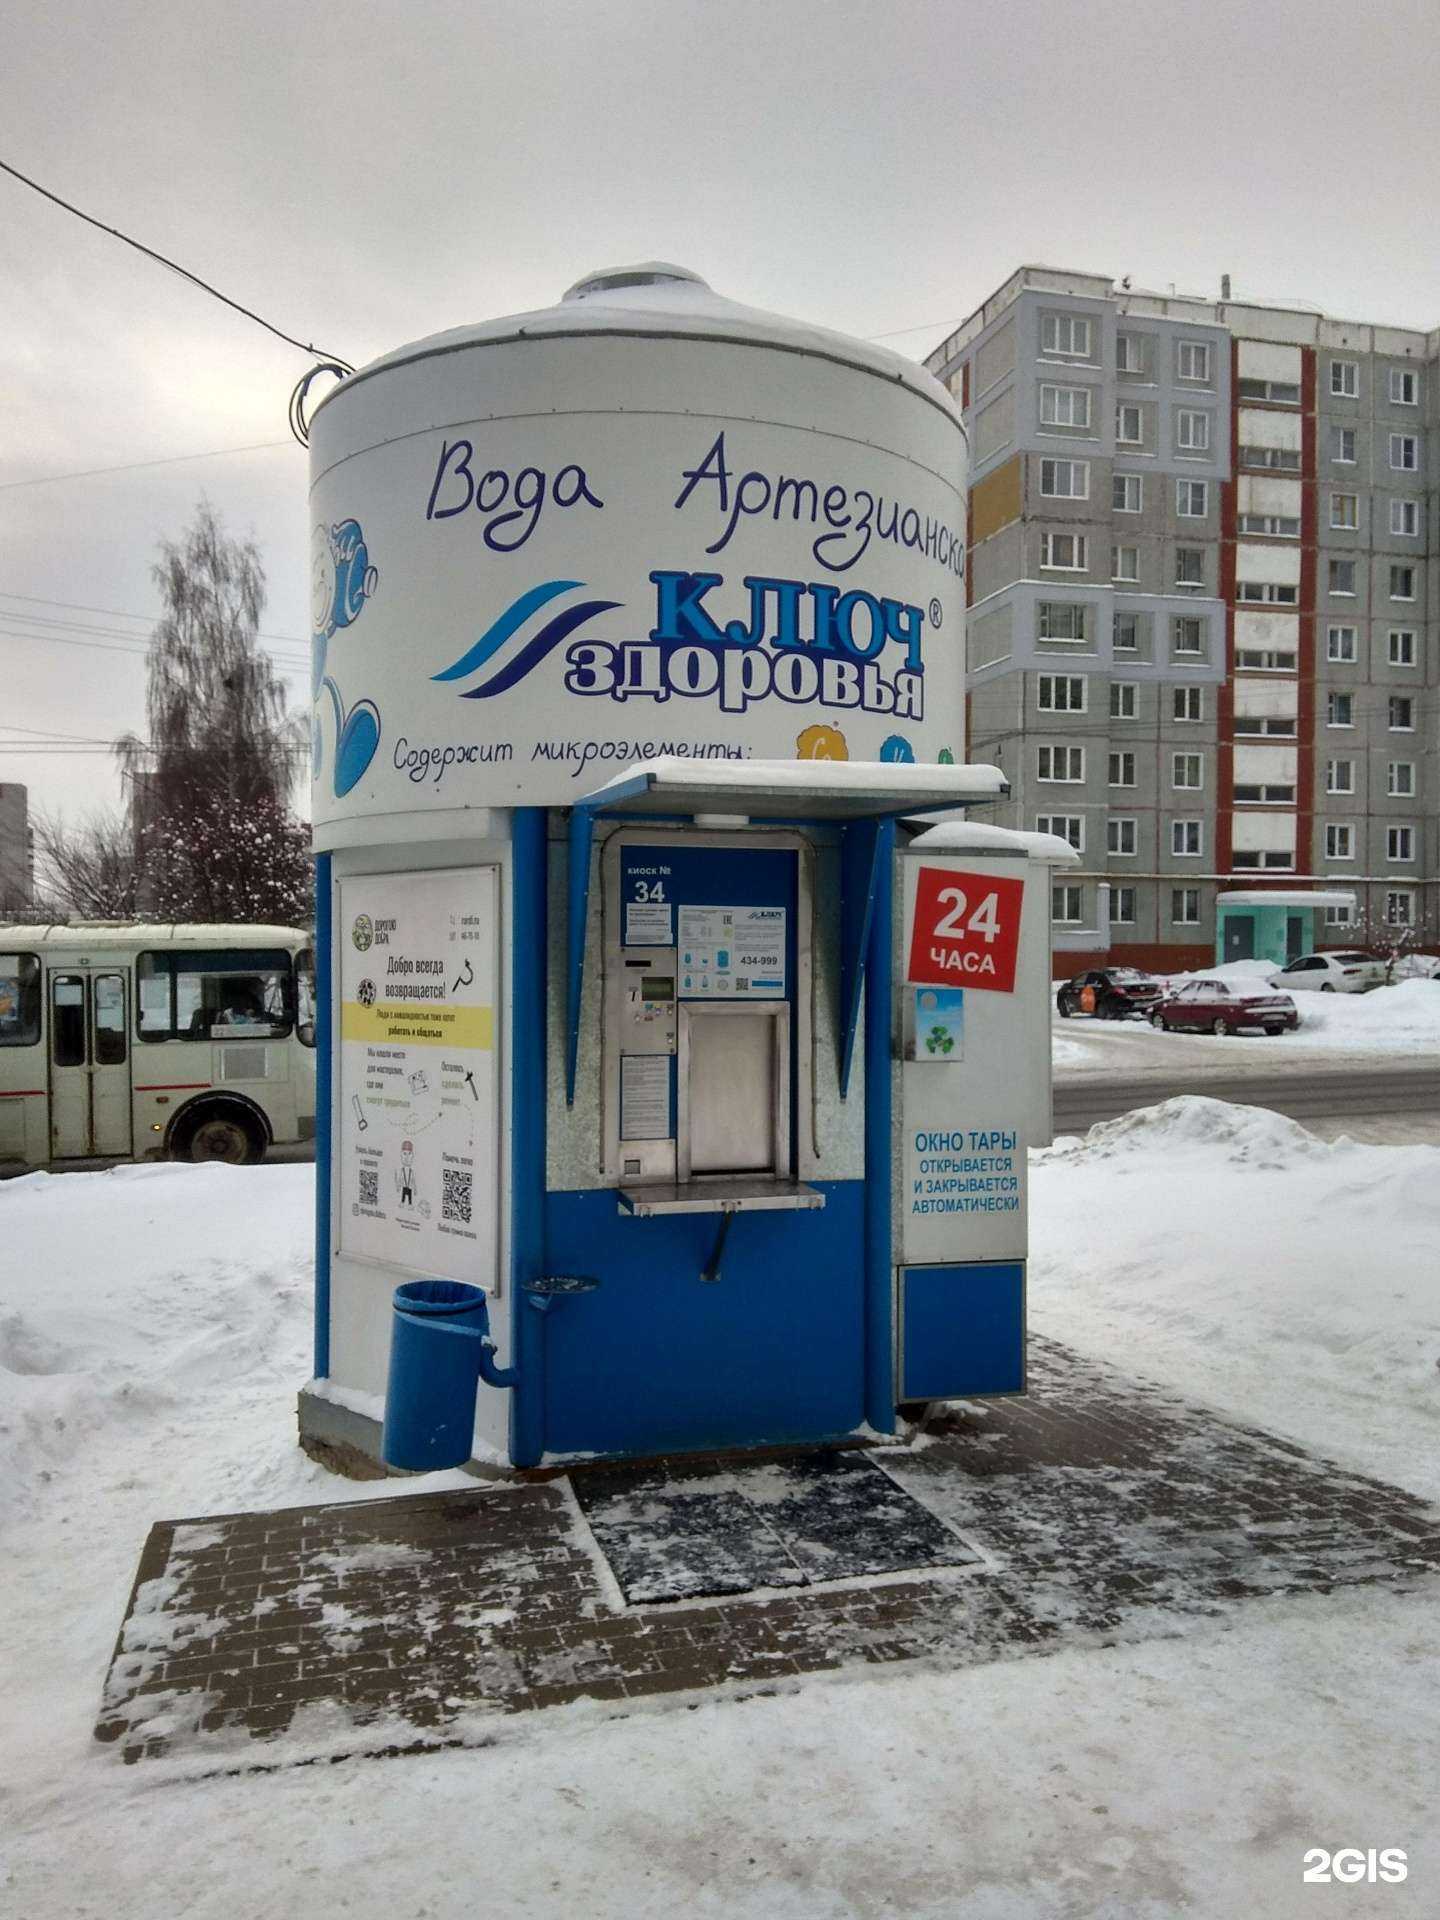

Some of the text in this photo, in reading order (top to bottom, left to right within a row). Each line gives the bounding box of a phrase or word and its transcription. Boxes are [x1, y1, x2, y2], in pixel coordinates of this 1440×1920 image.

[426, 439, 603, 552] Вода
[564, 639, 924, 721] здоровья
[393, 737, 753, 782] Содержит микроэлементы:
[635, 881, 665, 903] 34
[933, 887, 1000, 943] 24
[387, 956, 444, 976] Добро всегда
[740, 956, 778, 966] 434-999
[930, 947, 996, 975] ЧАСА
[385, 982, 446, 1000] возвращается!
[915, 1131, 1017, 1152] ОКНО ТАРЫ
[920, 1157, 1012, 1173] ОТКРЫВАЕТСЯ
[914, 1176, 1018, 1194] И ЗАКРЫВАЕТСЯ
[912, 1197, 1020, 1214] АВТОМАТИЧЕСКИ
